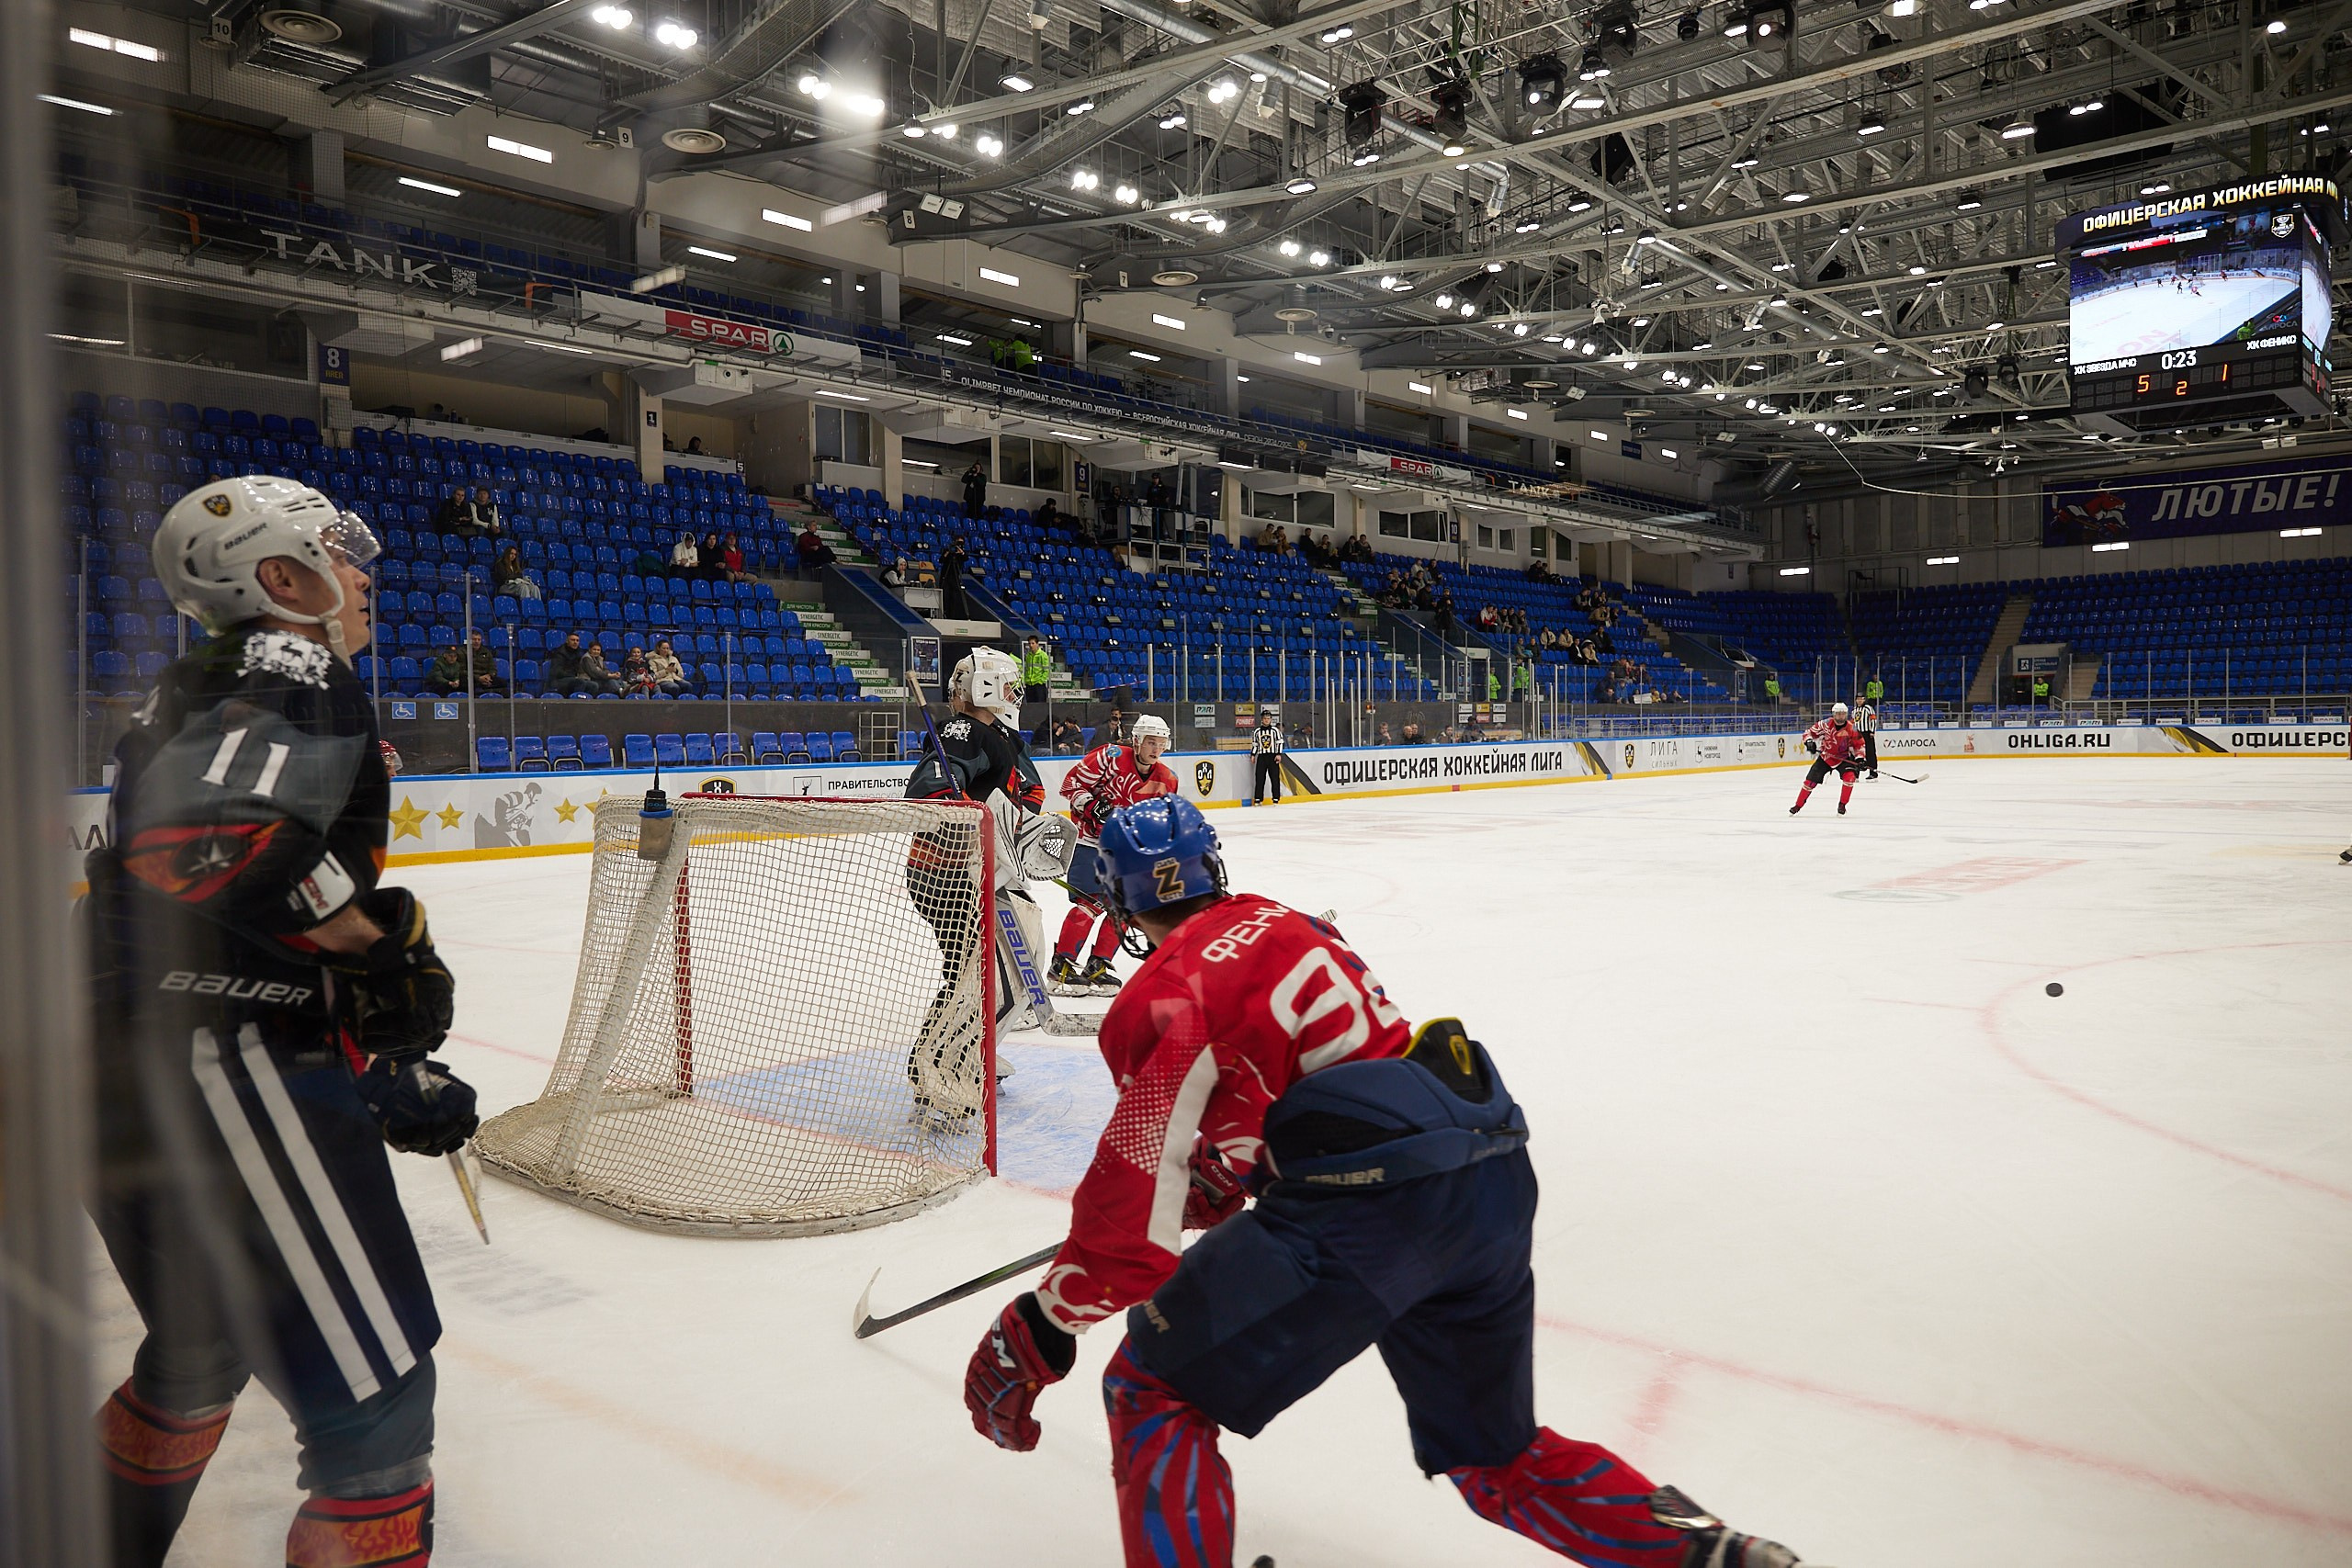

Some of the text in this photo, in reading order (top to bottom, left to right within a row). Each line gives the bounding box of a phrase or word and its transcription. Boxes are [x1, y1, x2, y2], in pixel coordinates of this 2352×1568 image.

[622, 132, 629, 143] 9
[2083, 194, 2206, 233] ОФИЦЕРСКАЯ
[2211, 175, 2324, 207] ХОККЕЙНАЯ
[906, 215, 912, 224] 8
[259, 230, 438, 288] TANK
[690, 319, 767, 344] SPAR
[326, 347, 340, 368] 8
[2161, 350, 2197, 369] 0:23
[2137, 375, 2150, 392] 5
[2176, 380, 2188, 395] 2
[1079, 468, 1086, 481] 9
[1400, 461, 1431, 476] SPAR
[2151, 474, 2340, 522] ЛЮТЫЕ!
[1650, 741, 1679, 757] ЛИГА
[2007, 733, 2110, 749] OHLIGA.RU
[200, 728, 290, 797] 11
[1323, 748, 1563, 786] ОФИЦЕРСКАЯ ХОККЕЙНАЯ ЛИГА
[828, 778, 910, 791] ПРАВИТЕЛЬСТВО
[1154, 863, 1183, 896] Z
[998, 909, 1046, 1006] BAUER
